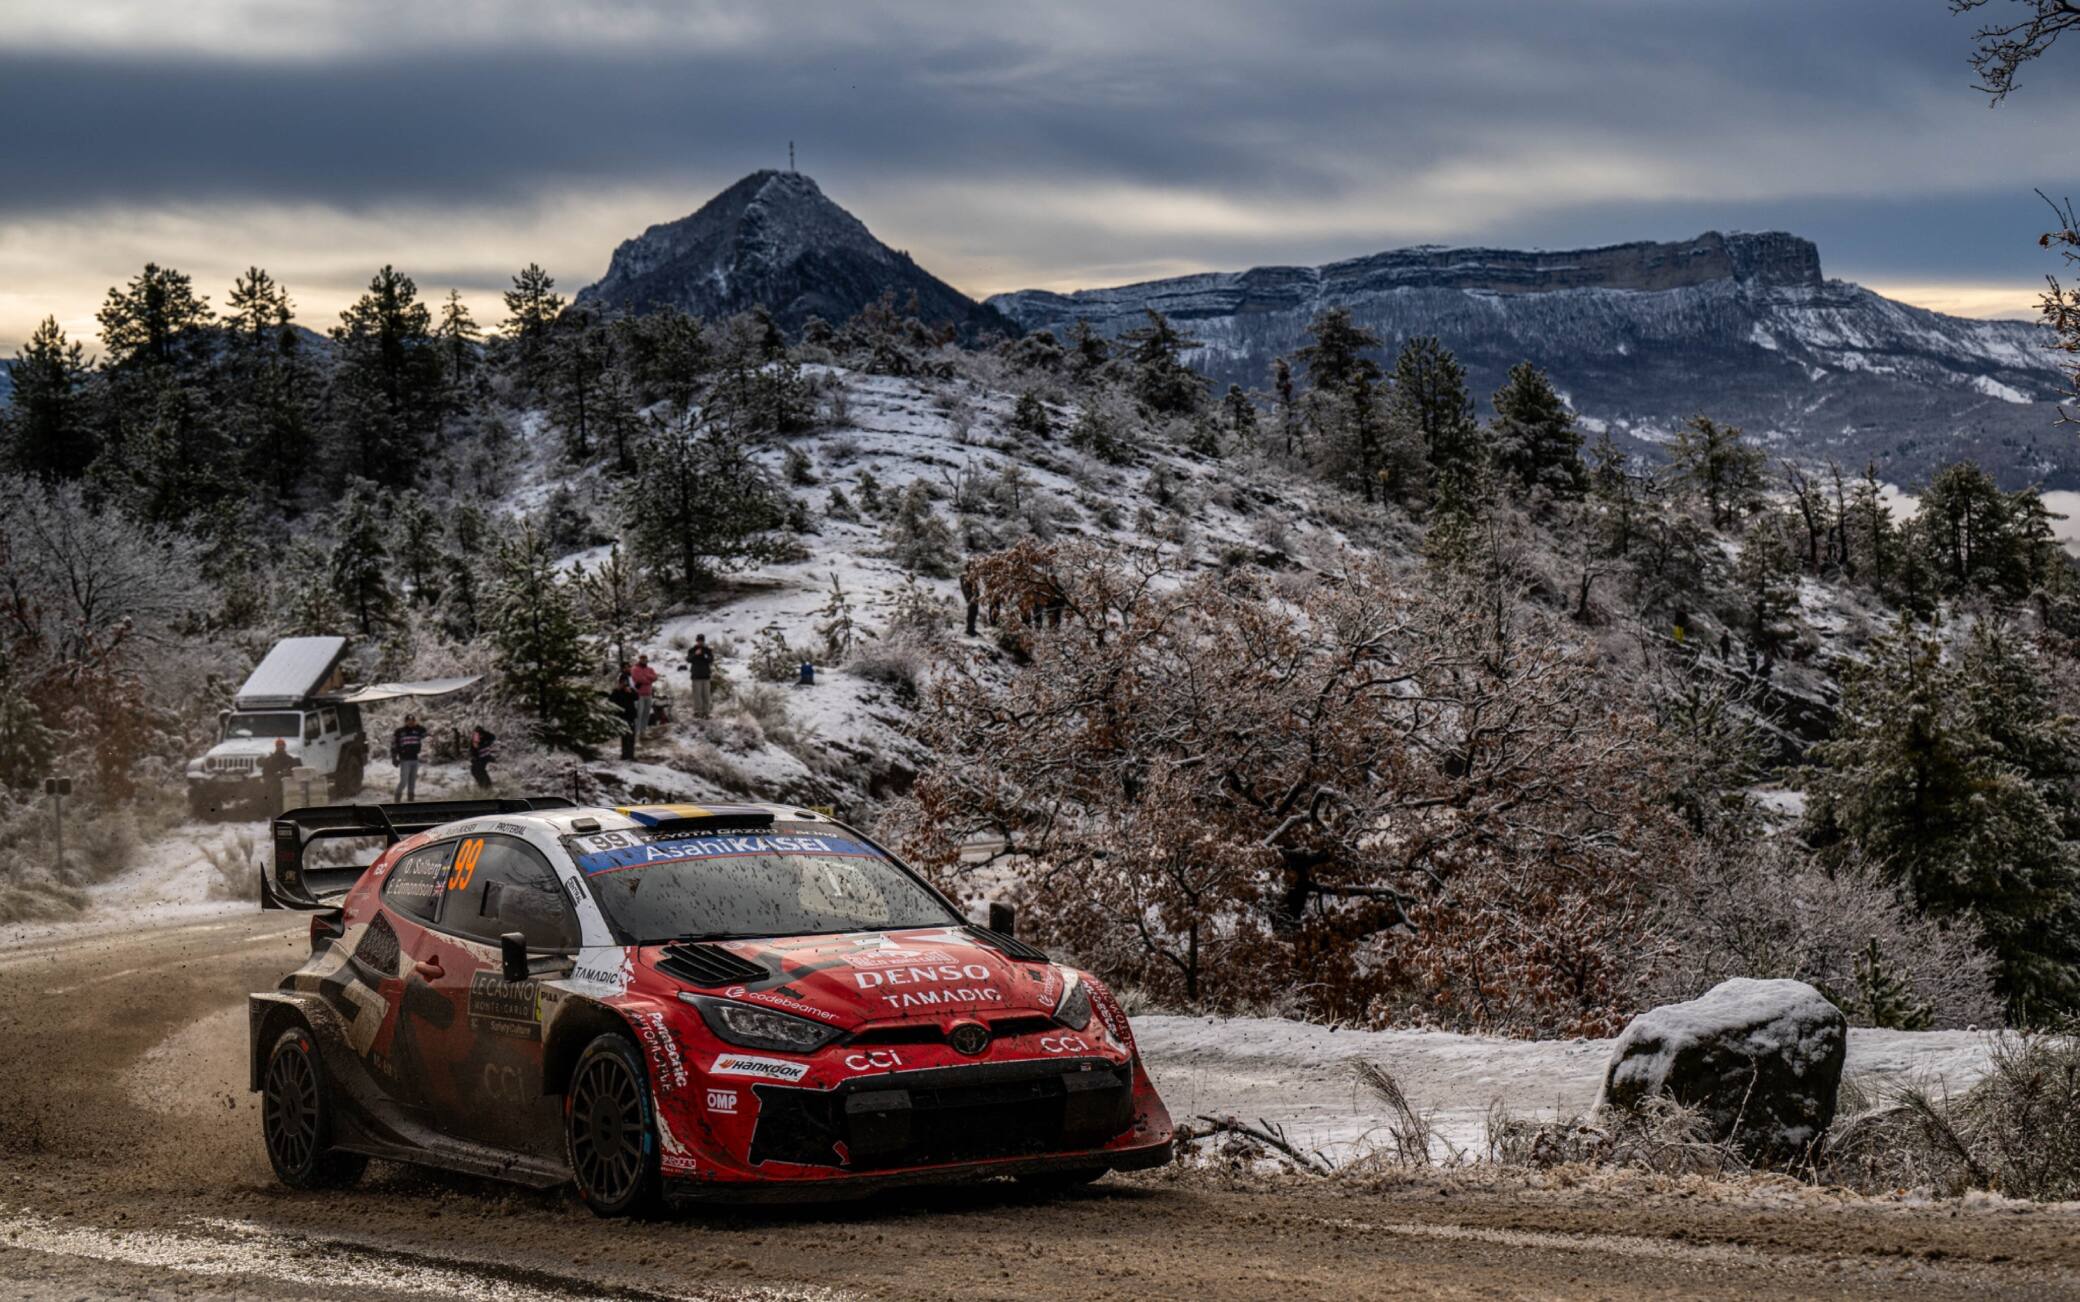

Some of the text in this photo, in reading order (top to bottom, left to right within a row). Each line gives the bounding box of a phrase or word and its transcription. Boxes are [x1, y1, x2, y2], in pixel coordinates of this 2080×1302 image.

[591, 833, 629, 851] 99
[717, 827, 779, 837] GAZOO
[448, 838, 485, 891] 99
[576, 966, 620, 987] TAMADIC
[854, 965, 991, 990] DENSO
[486, 978, 534, 1001] CASINO
[882, 988, 1001, 1009] TAMADIC
[749, 991, 836, 1021] codebeamer
[647, 1012, 689, 1088] Panasonic
[707, 1093, 738, 1110] OMP
